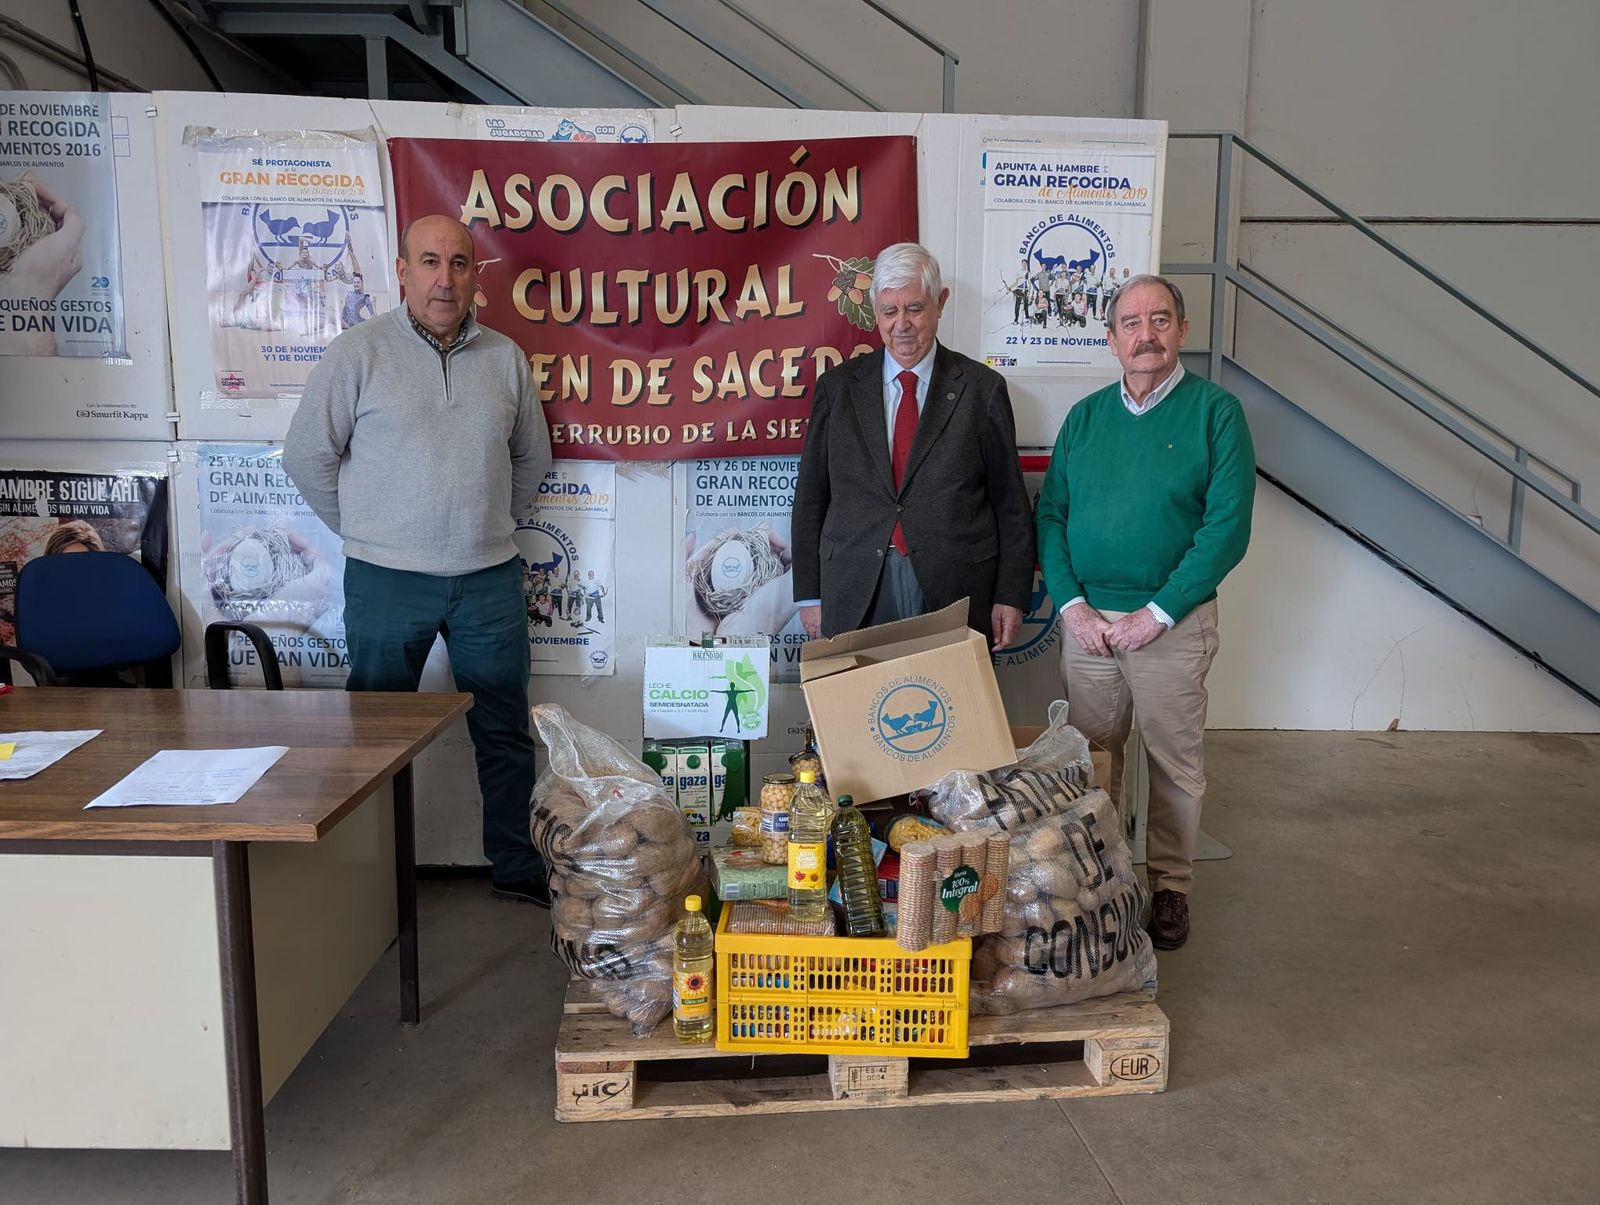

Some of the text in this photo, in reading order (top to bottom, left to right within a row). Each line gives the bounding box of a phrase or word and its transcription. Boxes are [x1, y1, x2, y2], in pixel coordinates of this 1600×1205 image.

[0, 104, 100, 118] DE NOVIEMBRE
[8, 121, 101, 138] RECOGIDA
[486, 119, 506, 130] LAS
[595, 126, 616, 136] CON
[490, 129, 545, 140] JUGADORAS
[0, 142, 102, 157] MENTOS 2016
[252, 158, 332, 168] SÉ PROTAGONISTA
[995, 162, 1037, 173] APUNTA
[1039, 163, 1054, 173] AL
[1055, 163, 1101, 174] HAMBRE
[219, 172, 366, 188] GRAN RECOGIDA
[993, 174, 1041, 188] GRAN
[1046, 176, 1131, 191] RECOGIDA
[459, 145, 861, 234] ASOCIACIÓN
[1037, 185, 1148, 202] de Alimentos 2019
[1023, 198, 1035, 206] CON
[1073, 200, 1104, 208] ALIMENTOS
[1104, 200, 1113, 208] DE
[1113, 201, 1148, 209] SALAMANCA
[1018, 213, 1116, 259] BANCO DE ALIMENTOS
[511, 263, 805, 326] CULTURAL
[0, 297, 112, 313] QUEÑOS GESTOS
[12, 315, 56, 333] DAN
[61, 315, 113, 334] VIDA
[1005, 336, 1110, 347] 22 Y 23 DE NOVIEMB
[261, 345, 273, 354] 30
[275, 345, 288, 354] DE
[264, 354, 270, 362] Y
[278, 354, 293, 362] DE
[608, 358, 675, 409] DE
[692, 344, 873, 404] SACED
[91, 410, 149, 422] Smurfit Kappa
[681, 422, 716, 444] DE
[727, 417, 759, 440] LA
[209, 455, 224, 467] 25
[256, 458, 273, 469] DE
[696, 460, 711, 471] 25
[713, 460, 721, 471] Y
[724, 461, 739, 471] 26
[742, 461, 758, 471] DE
[209, 471, 259, 487] GRAN
[696, 475, 743, 489] GRAN
[110, 478, 140, 503] AHÍ
[538, 482, 592, 496] OGIDA
[210, 491, 308, 506] DE ALIMENTO
[583, 492, 609, 505] 2019
[696, 494, 794, 507] DE ALIMENTOS
[59, 505, 71, 515] NO
[73, 505, 90, 515] HAY
[91, 506, 111, 516] VIDA
[575, 505, 609, 513] SALAMANCA
[527, 518, 579, 562] ALIMENTOS
[529, 636, 589, 646] NOVIEMBRE
[229, 649, 352, 669] UE AN VIDA
[649, 689, 710, 701] CALCIO
[867, 675, 952, 724] BANCOS DE ALIMENTOS
[872, 715, 956, 763] BANCOS DE ALIMENTOS
[679, 775, 708, 791] gaza
[941, 881, 978, 899] Integral
[1121, 1057, 1149, 1077] EUR
